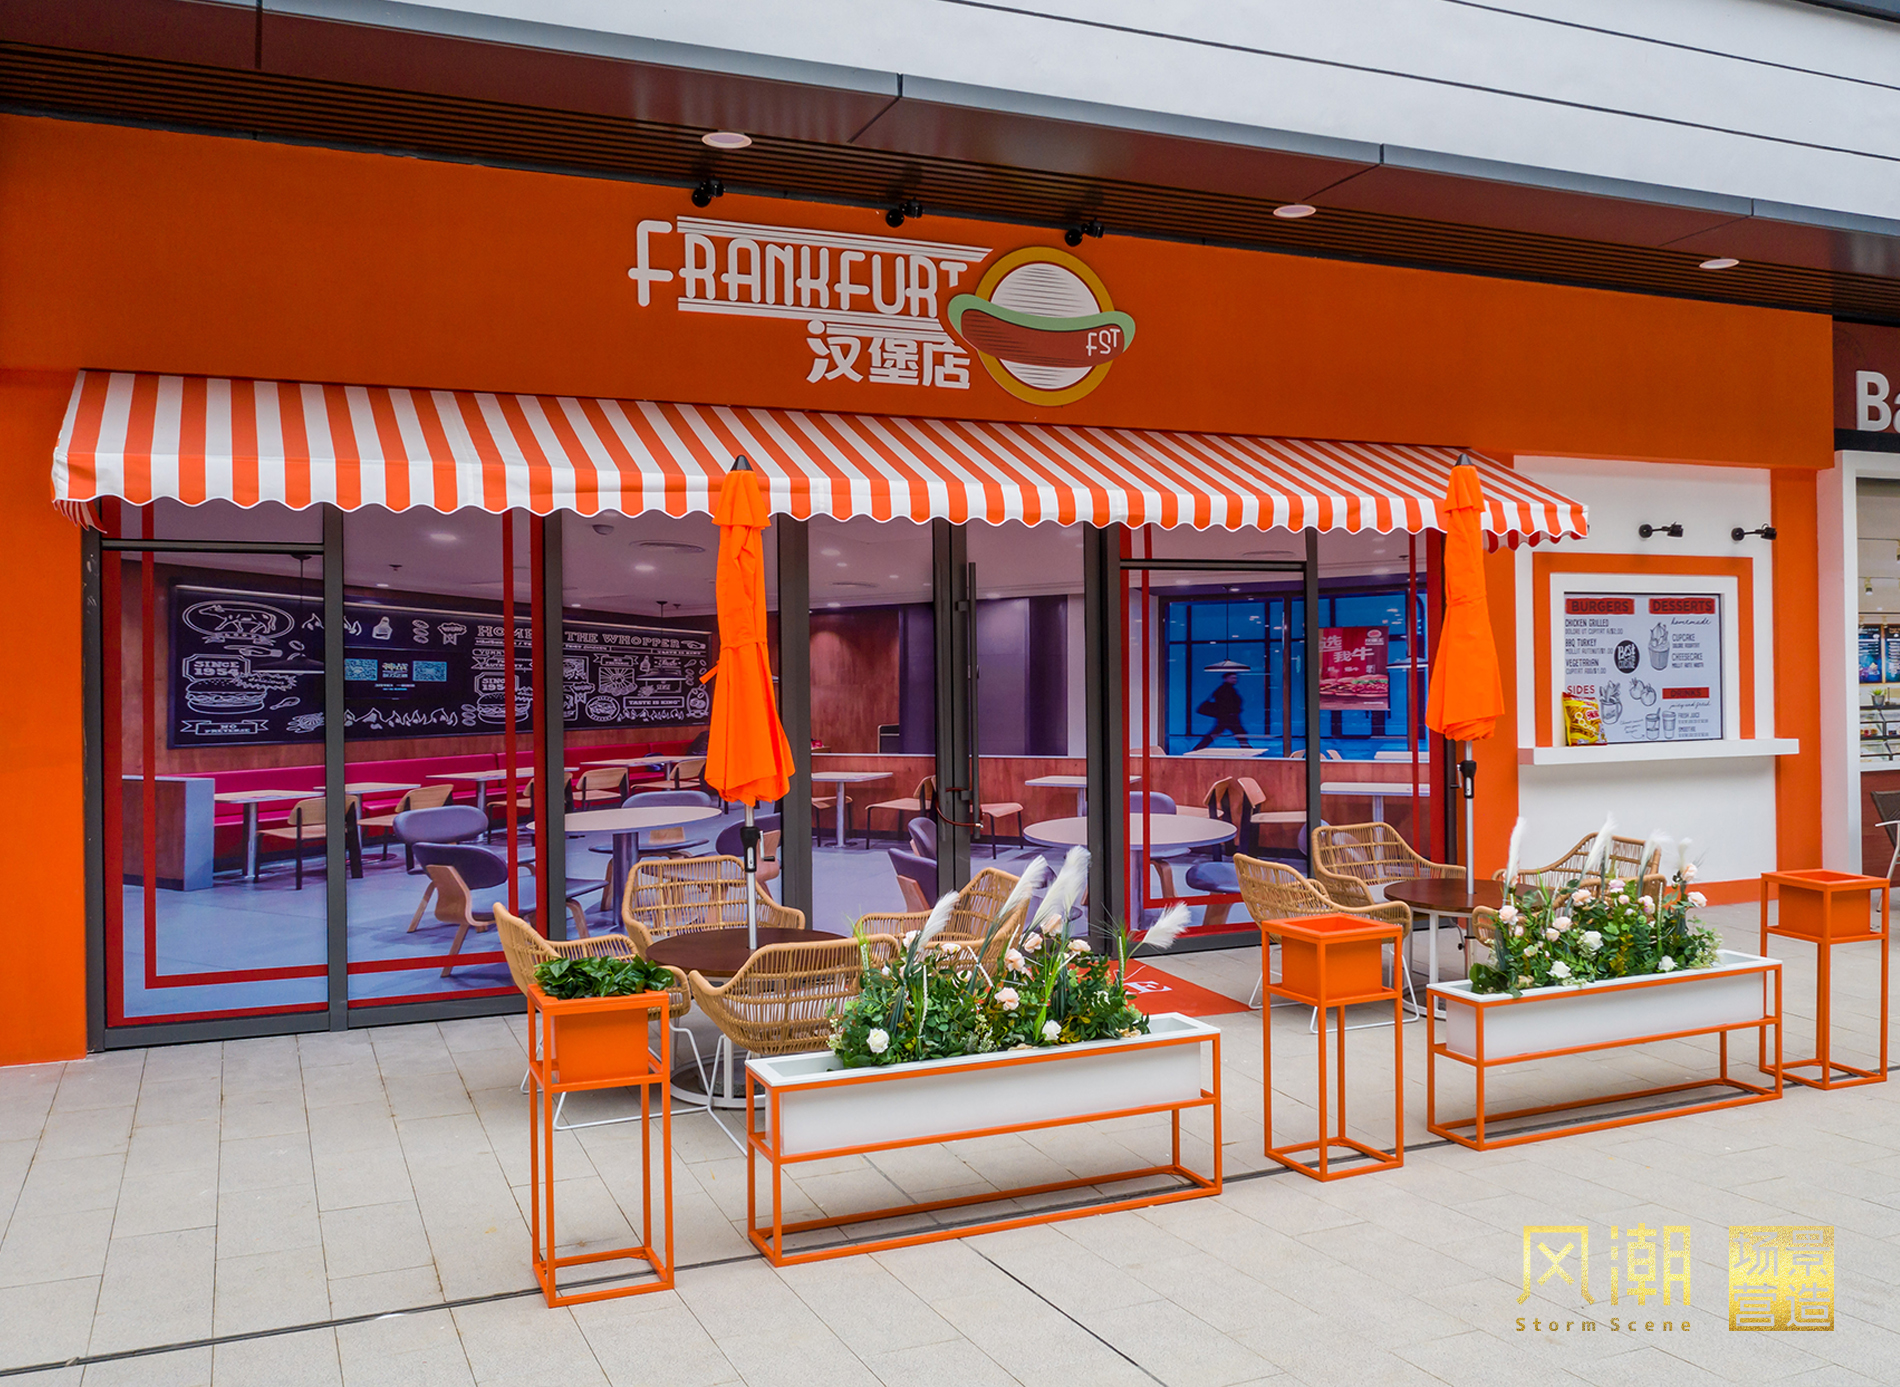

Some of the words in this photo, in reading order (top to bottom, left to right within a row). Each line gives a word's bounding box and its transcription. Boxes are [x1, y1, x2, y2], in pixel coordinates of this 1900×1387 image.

[628, 219, 968, 318] FRANKFURT
[1086, 328, 1121, 357] FST
[806, 320, 971, 389] 汉堡店
[1572, 600, 1629, 612] BURGERS
[1652, 600, 1712, 612] DESSERTS
[1565, 619, 1587, 627] CHICKEN
[1589, 619, 1609, 627] GRILLED
[1671, 617, 1711, 625] homemade
[564, 631, 598, 644] THE
[602, 634, 681, 648] WHOPPER
[1672, 633, 1695, 642] CUPCAKE
[1577, 638, 1597, 647] TURKEY
[1672, 652, 1703, 661] CHEESECAKE
[193, 660, 240, 668] SINCE
[1565, 658, 1599, 667] VEGETARIAN
[194, 668, 240, 676] 1954
[1566, 685, 1595, 694] SIDES
[1670, 689, 1701, 697] DRINKS
